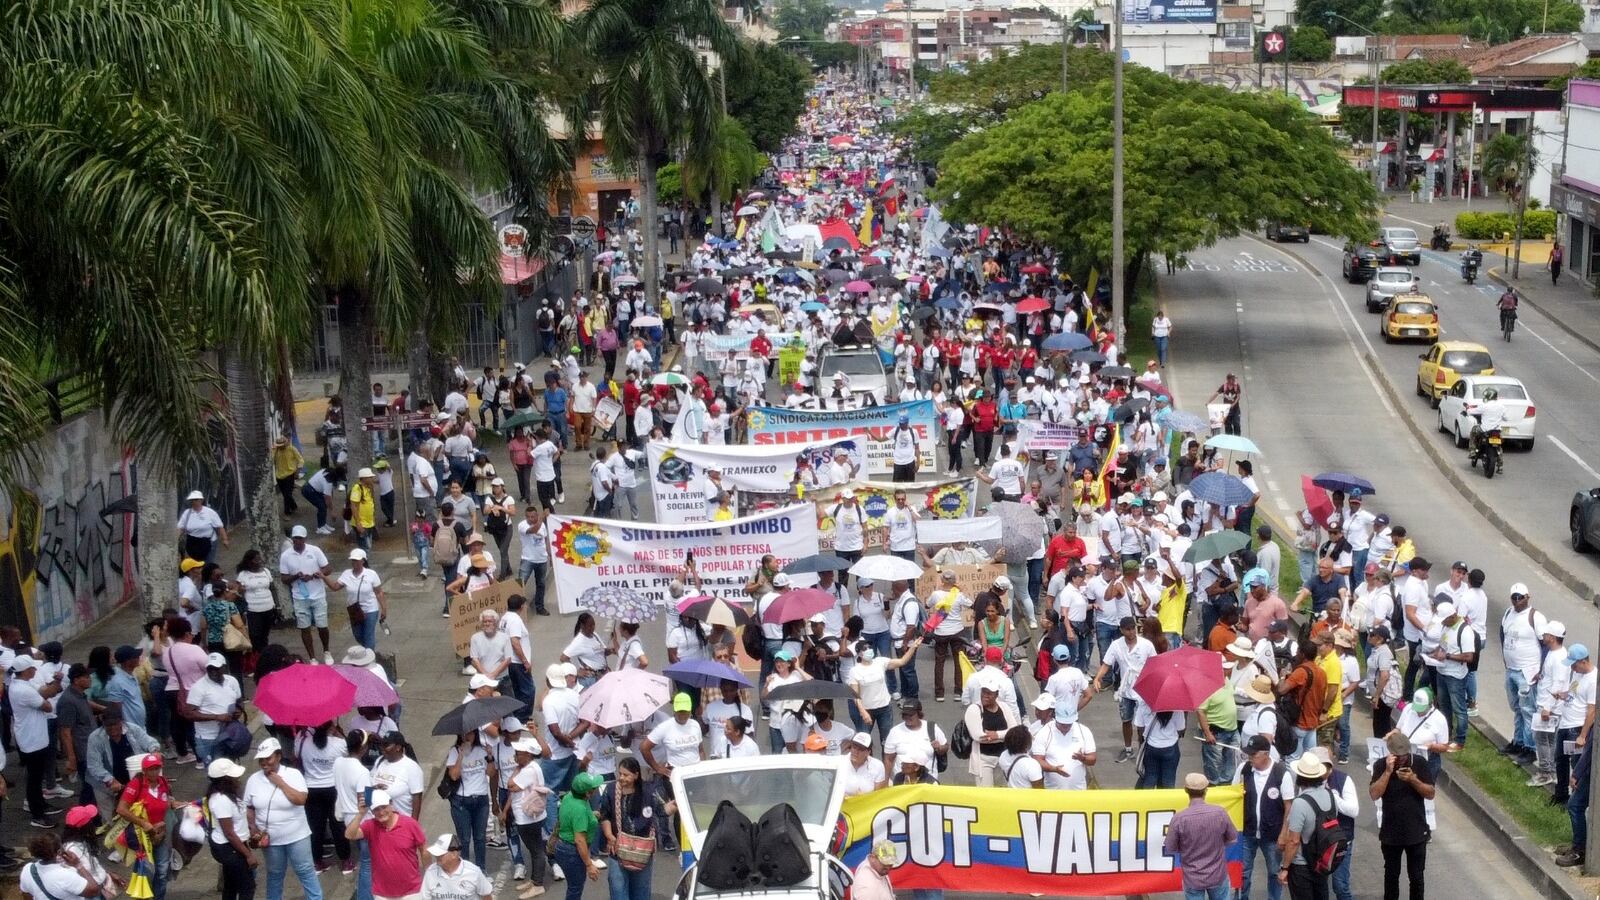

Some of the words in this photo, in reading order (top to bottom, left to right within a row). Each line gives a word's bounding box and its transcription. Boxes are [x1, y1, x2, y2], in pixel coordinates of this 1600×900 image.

[769, 412, 830, 425] SINDICATO
[832, 411, 889, 422] NACIONAL
[656, 493, 666, 501] EN
[668, 492, 678, 500] LA
[666, 501, 704, 511] SOCIALES
[729, 516, 792, 536] YUMBO
[633, 551, 656, 561] MAS
[658, 549, 670, 559] DE
[672, 548, 684, 558] 56
[714, 545, 727, 556] EN
[730, 543, 772, 555] DEFENSA
[597, 566, 610, 576] DE
[612, 564, 624, 575] LA
[626, 563, 657, 574] CLASE
[701, 560, 745, 573] POPULAR
[747, 559, 753, 570] Y
[633, 579, 649, 588] EL
[717, 577, 734, 585] DE
[872, 802, 978, 869] CUT
[988, 837, 1012, 852] -
[1018, 809, 1176, 875] VALLE
